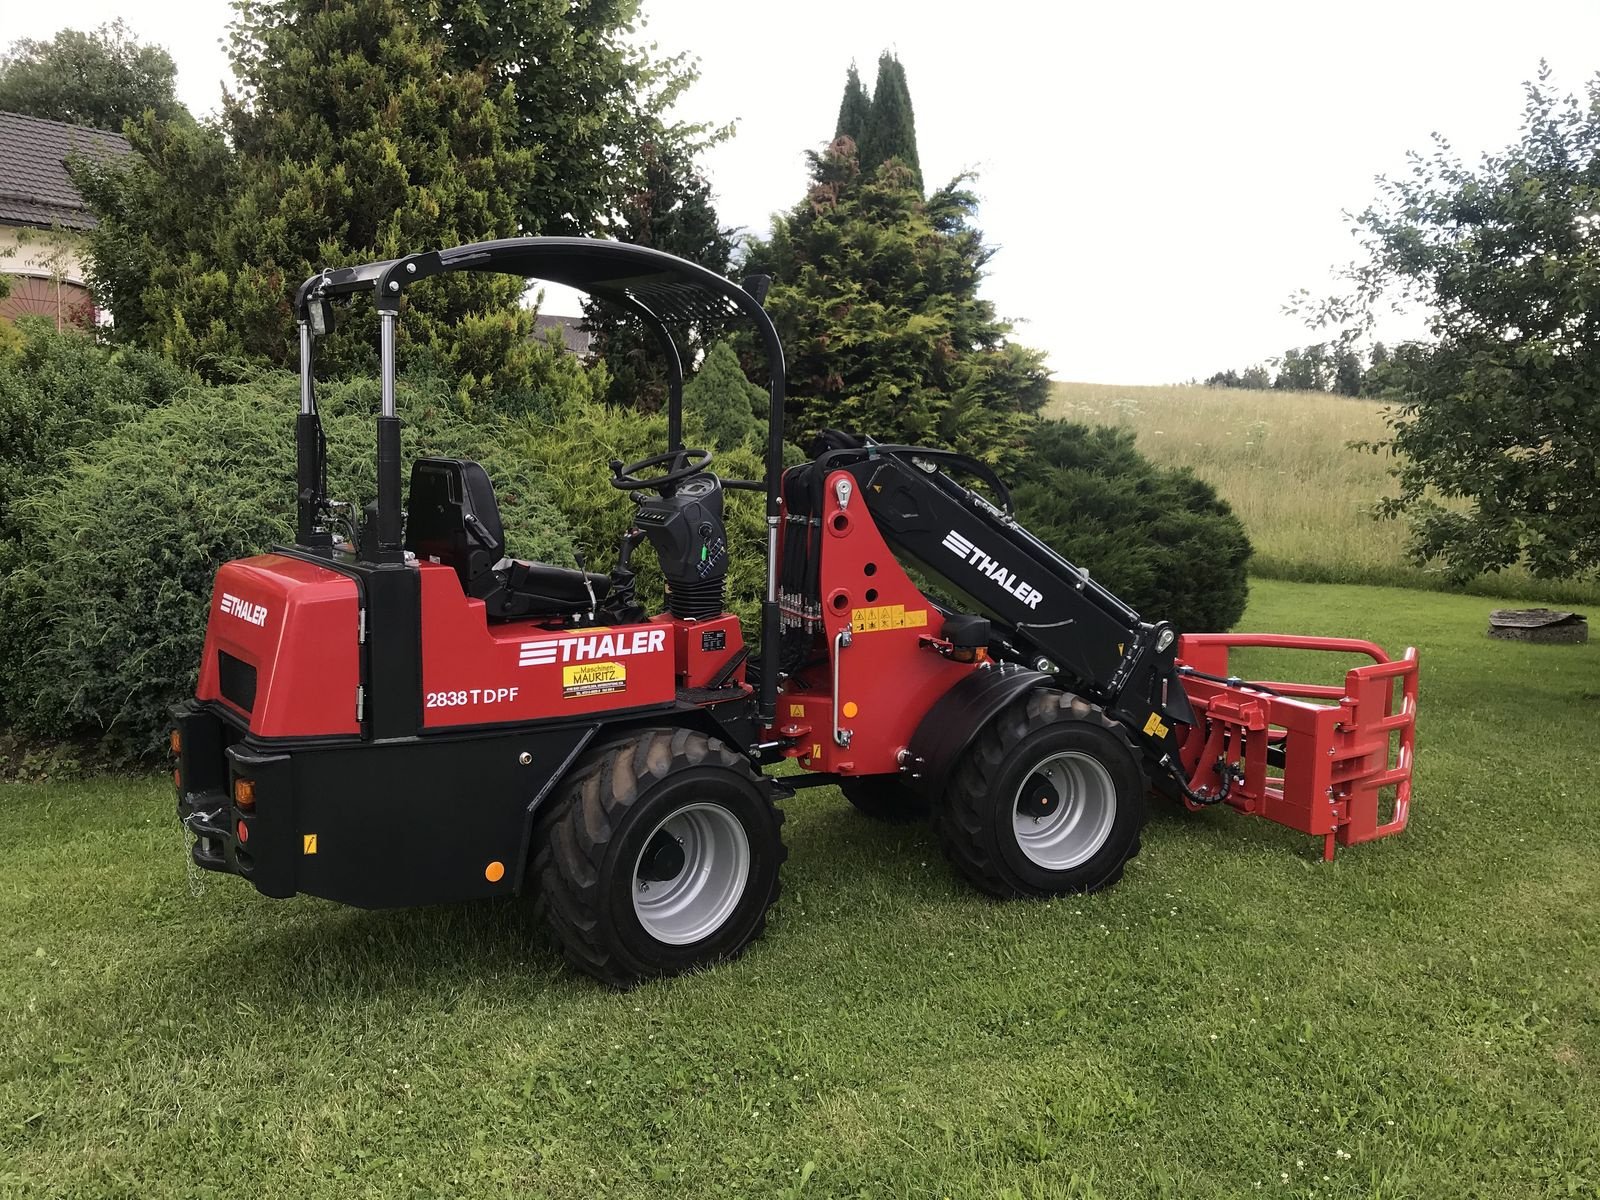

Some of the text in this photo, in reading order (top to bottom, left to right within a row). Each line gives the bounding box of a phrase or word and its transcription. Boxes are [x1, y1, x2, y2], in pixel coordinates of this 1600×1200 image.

[968, 546, 1044, 611] THALER
[230, 596, 268, 628] THALER
[558, 629, 666, 662] THALER
[573, 670, 616, 684] MAURITZ
[426, 690, 468, 708] 2838
